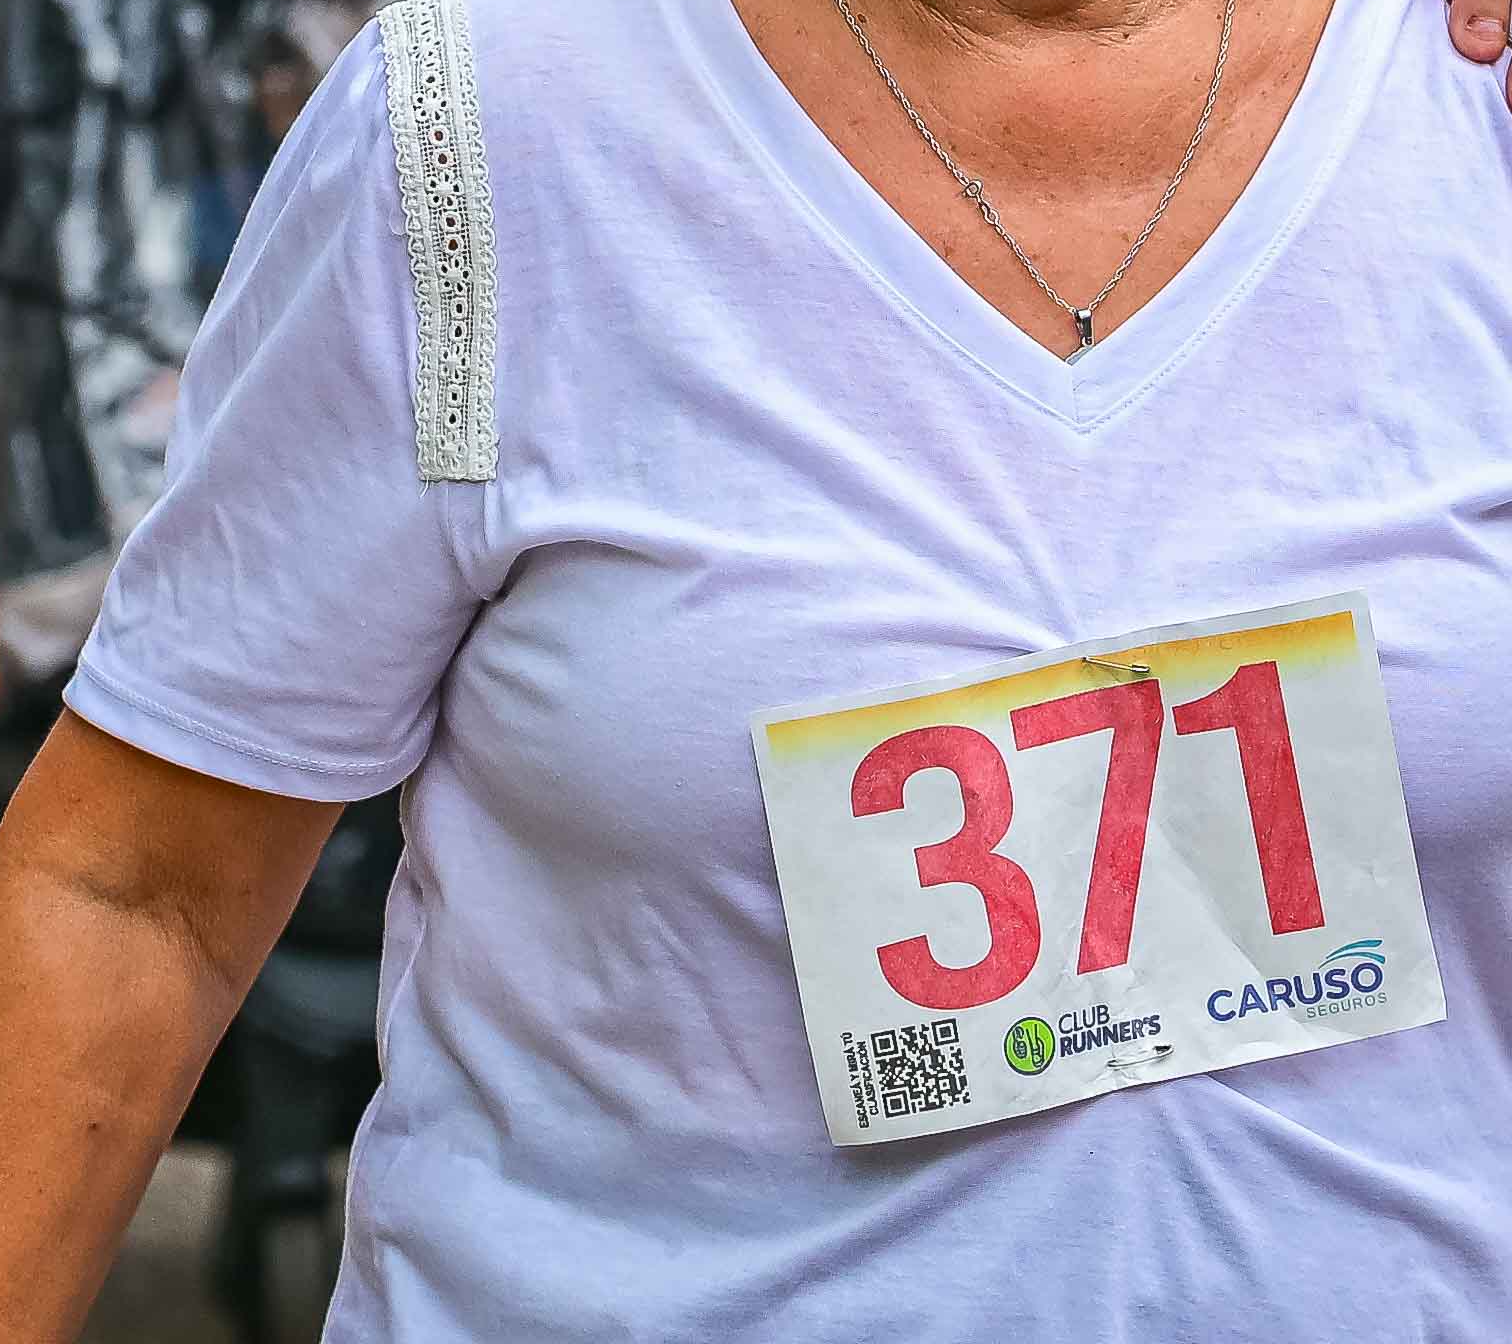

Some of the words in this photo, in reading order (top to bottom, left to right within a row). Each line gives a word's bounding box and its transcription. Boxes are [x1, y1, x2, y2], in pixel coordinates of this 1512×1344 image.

[850, 660, 1325, 1010] 371
[1206, 962, 1384, 1022] CARUSO
[1306, 992, 1388, 1019] SEGUROS
[1058, 1004, 1110, 1034] CLUB
[1059, 1015, 1161, 1057] RUNNER'S
